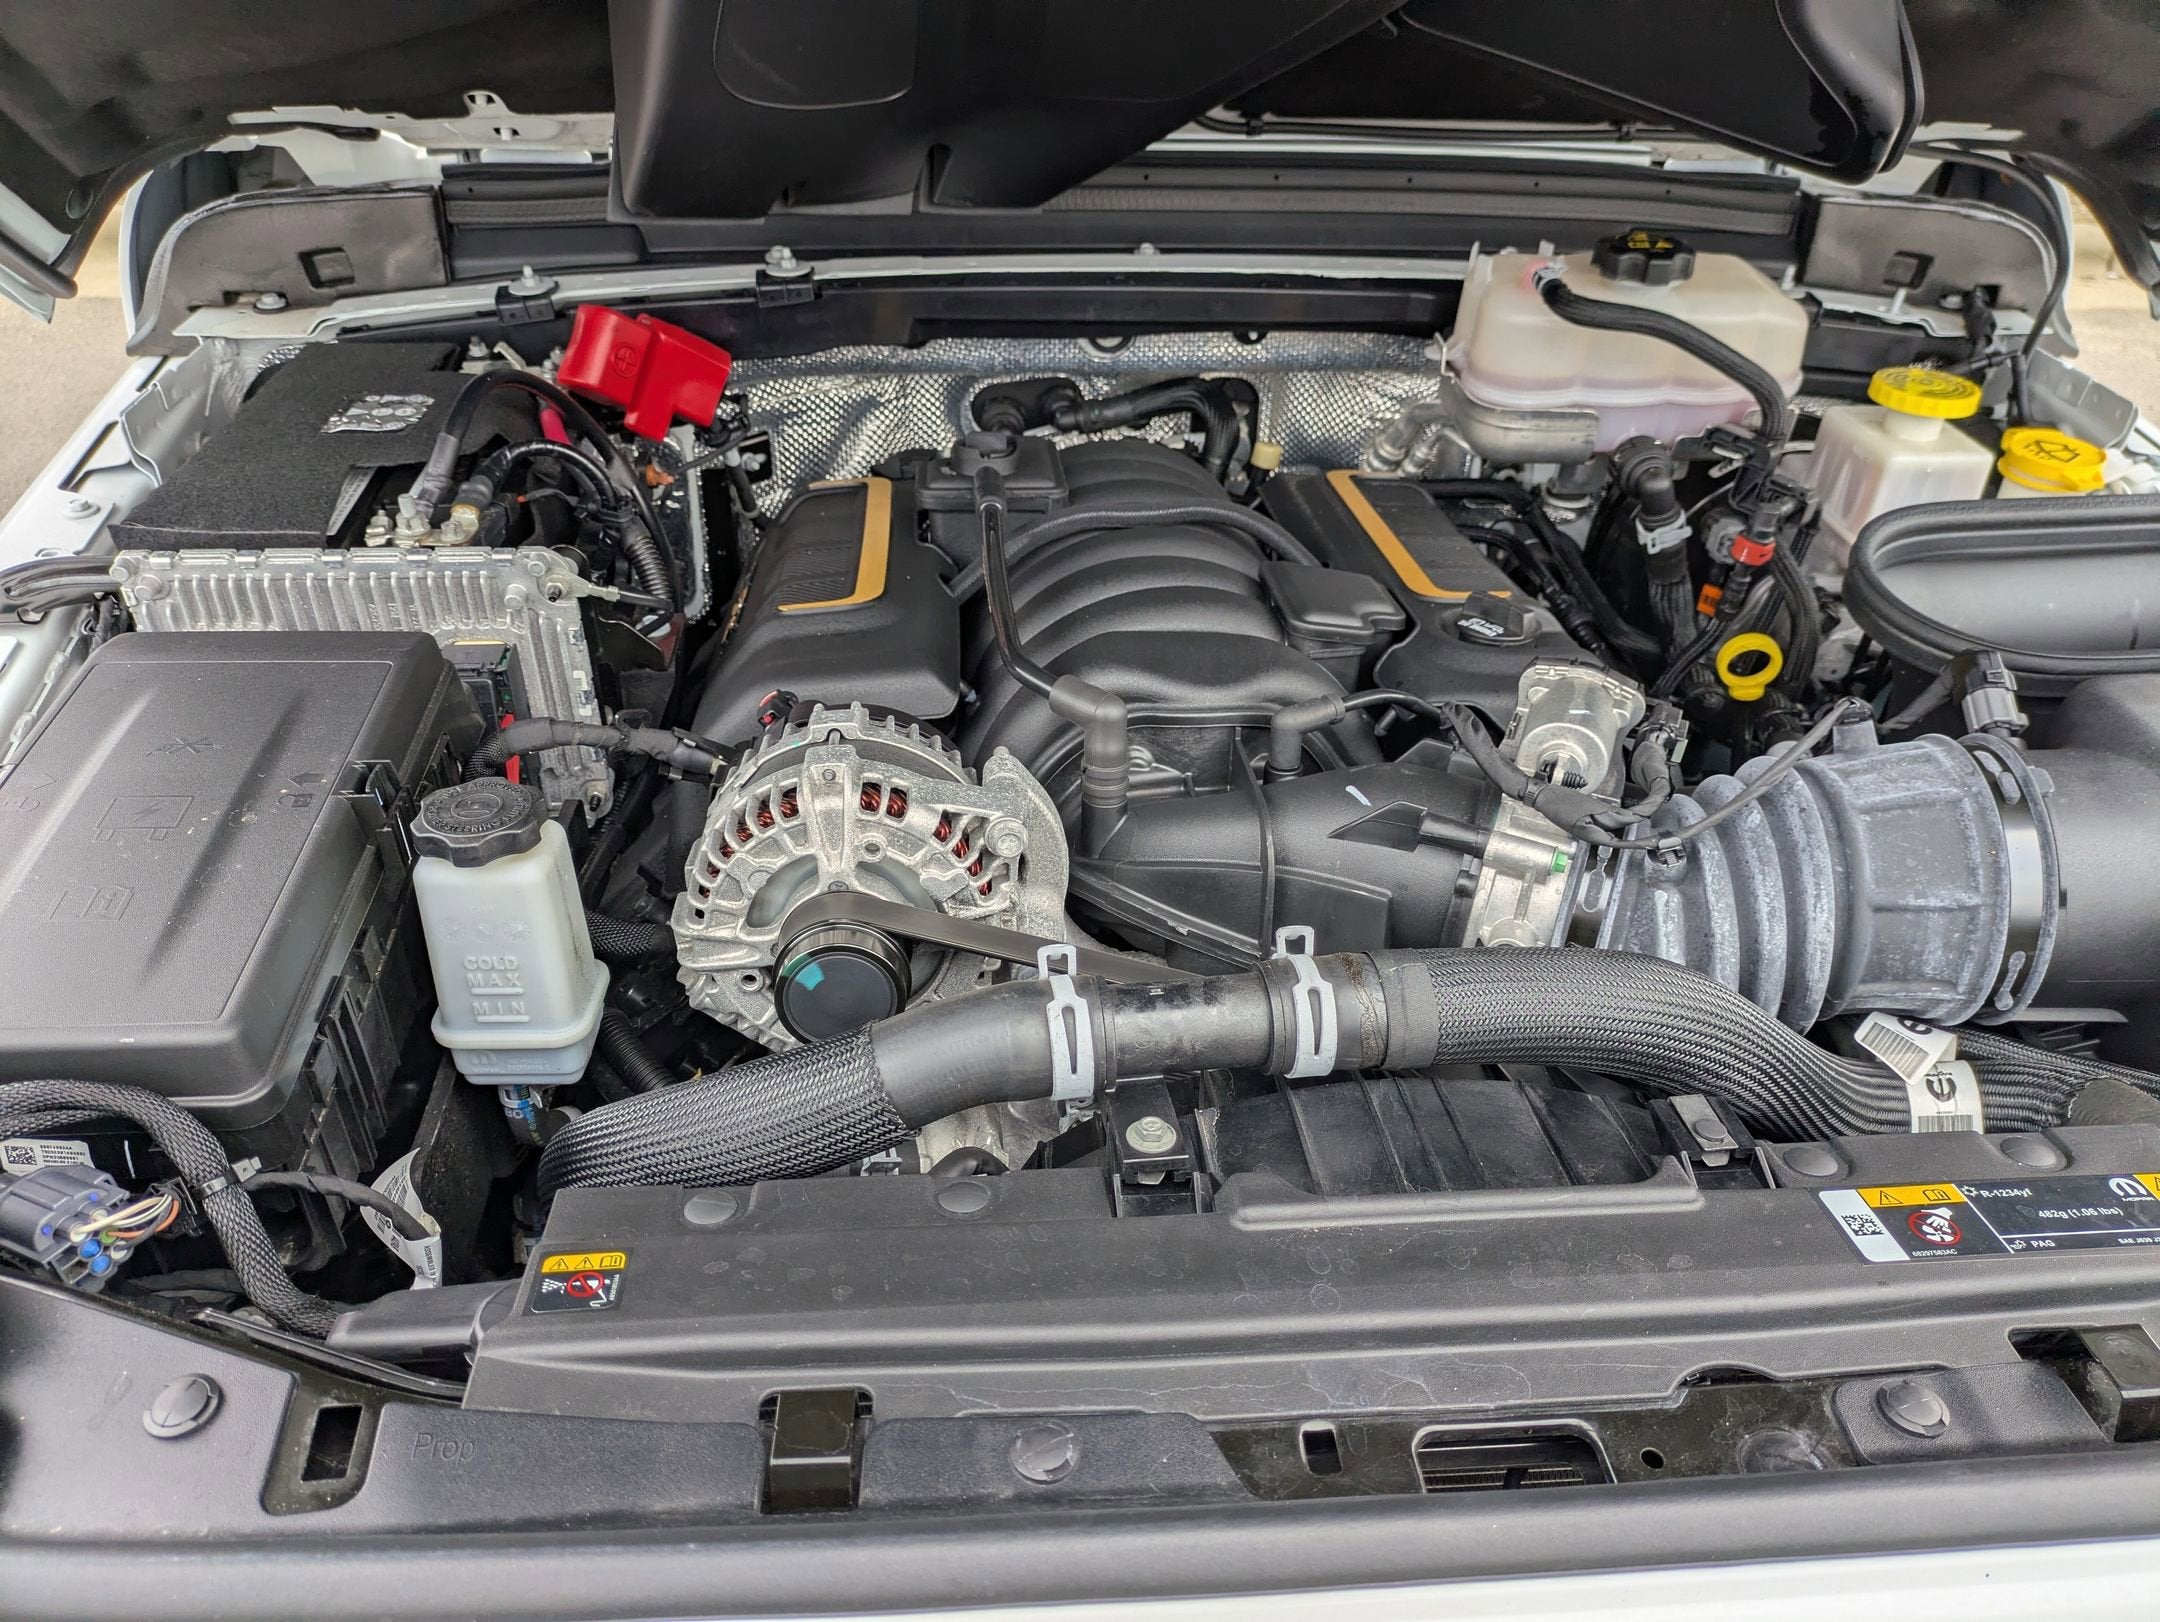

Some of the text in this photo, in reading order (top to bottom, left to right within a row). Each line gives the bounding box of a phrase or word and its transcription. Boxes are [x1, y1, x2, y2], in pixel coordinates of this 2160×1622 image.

[463, 955, 519, 971] COLD
[466, 972, 521, 987] MAX
[472, 1001, 526, 1016] MIN
[2038, 1206, 2124, 1219] 482g (1.06 lbs)
[2030, 1239, 2056, 1248] PAG
[411, 1431, 475, 1467] Prop
